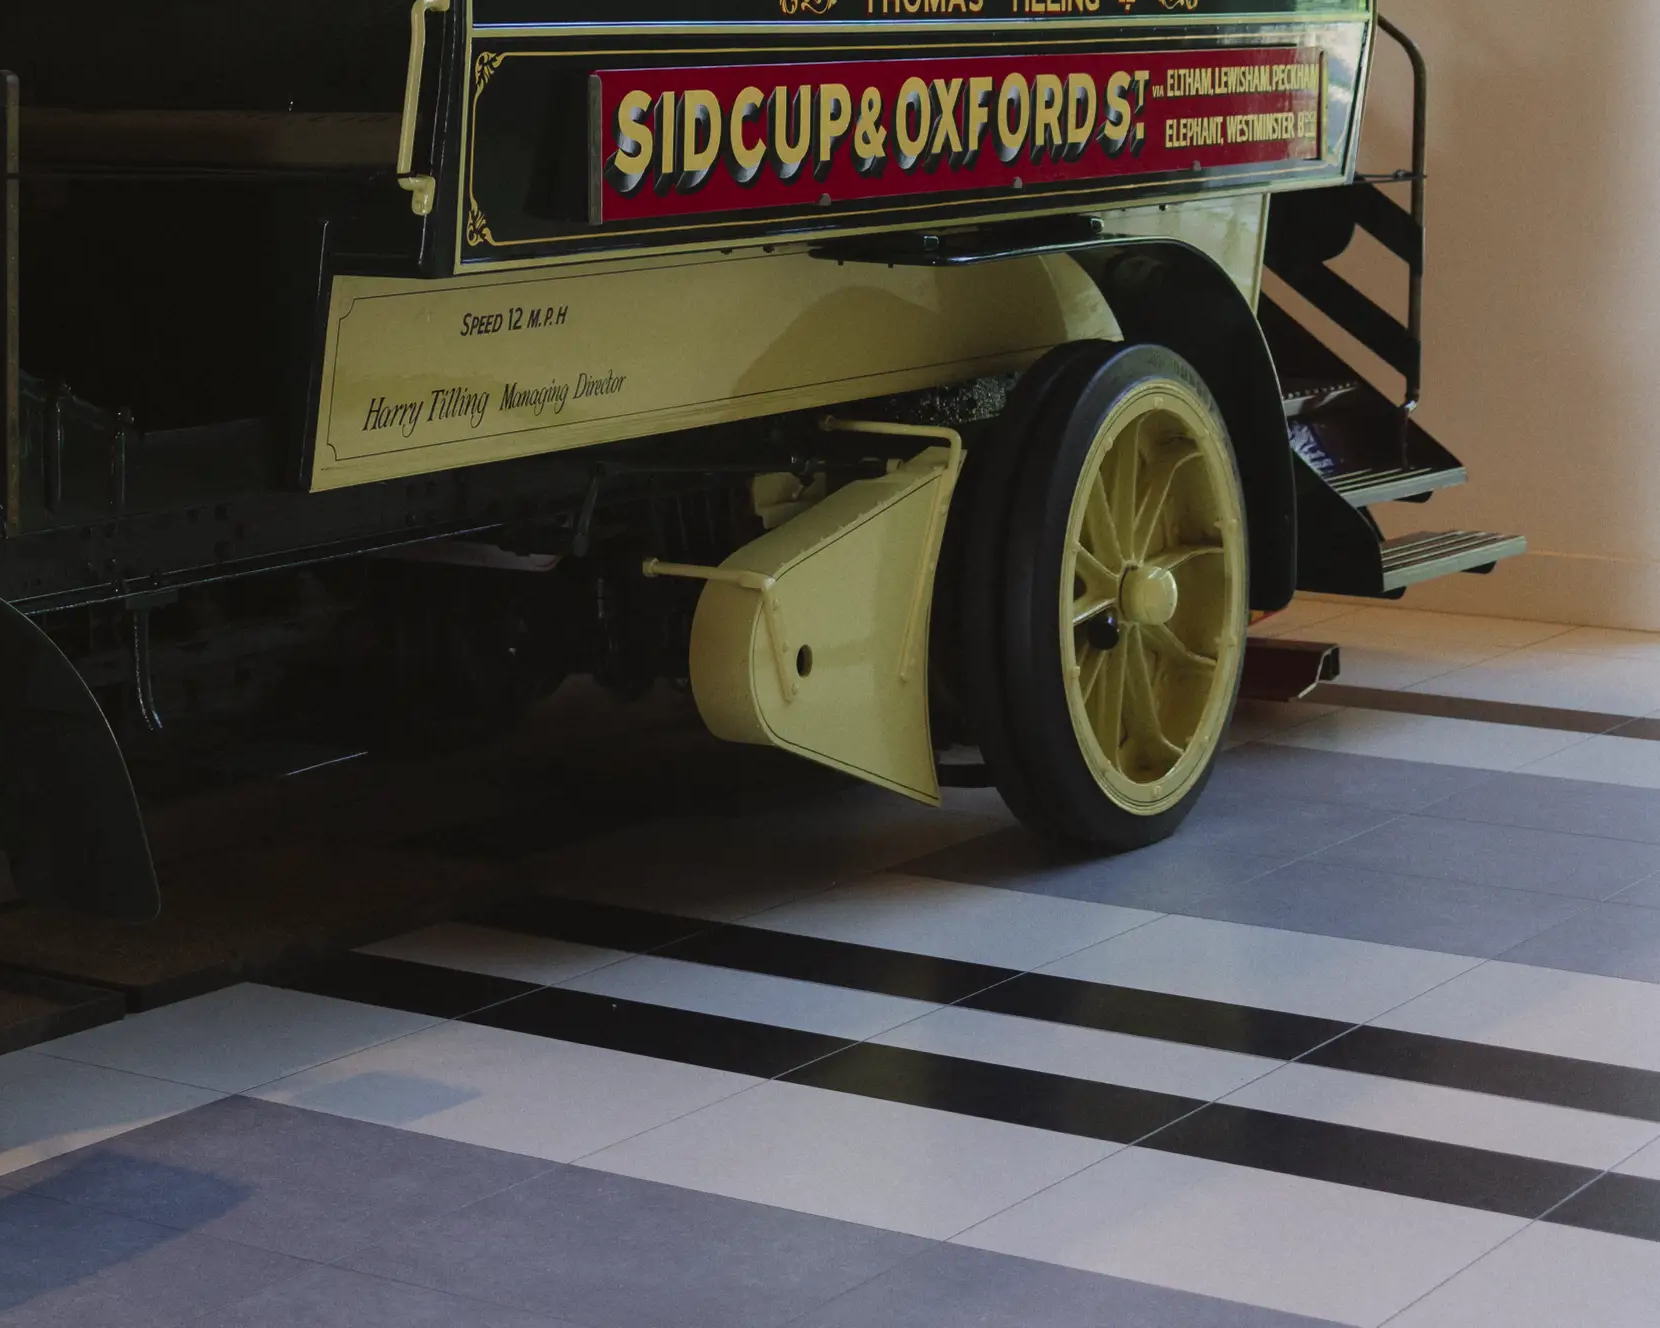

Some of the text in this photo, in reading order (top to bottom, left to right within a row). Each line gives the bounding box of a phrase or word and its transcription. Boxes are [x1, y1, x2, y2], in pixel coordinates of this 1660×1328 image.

[1152, 85, 1164, 98] VIA
[1167, 67, 1214, 97] ELTHAM,
[1272, 63, 1319, 92] PECKHAM
[1165, 116, 1224, 148] ELEPHANT,
[1226, 112, 1295, 144] WESTMINSTER
[460, 312, 503, 337] SPEED
[508, 307, 523, 332] 12
[362, 369, 627, 438] Harry Tilling Managing Director
